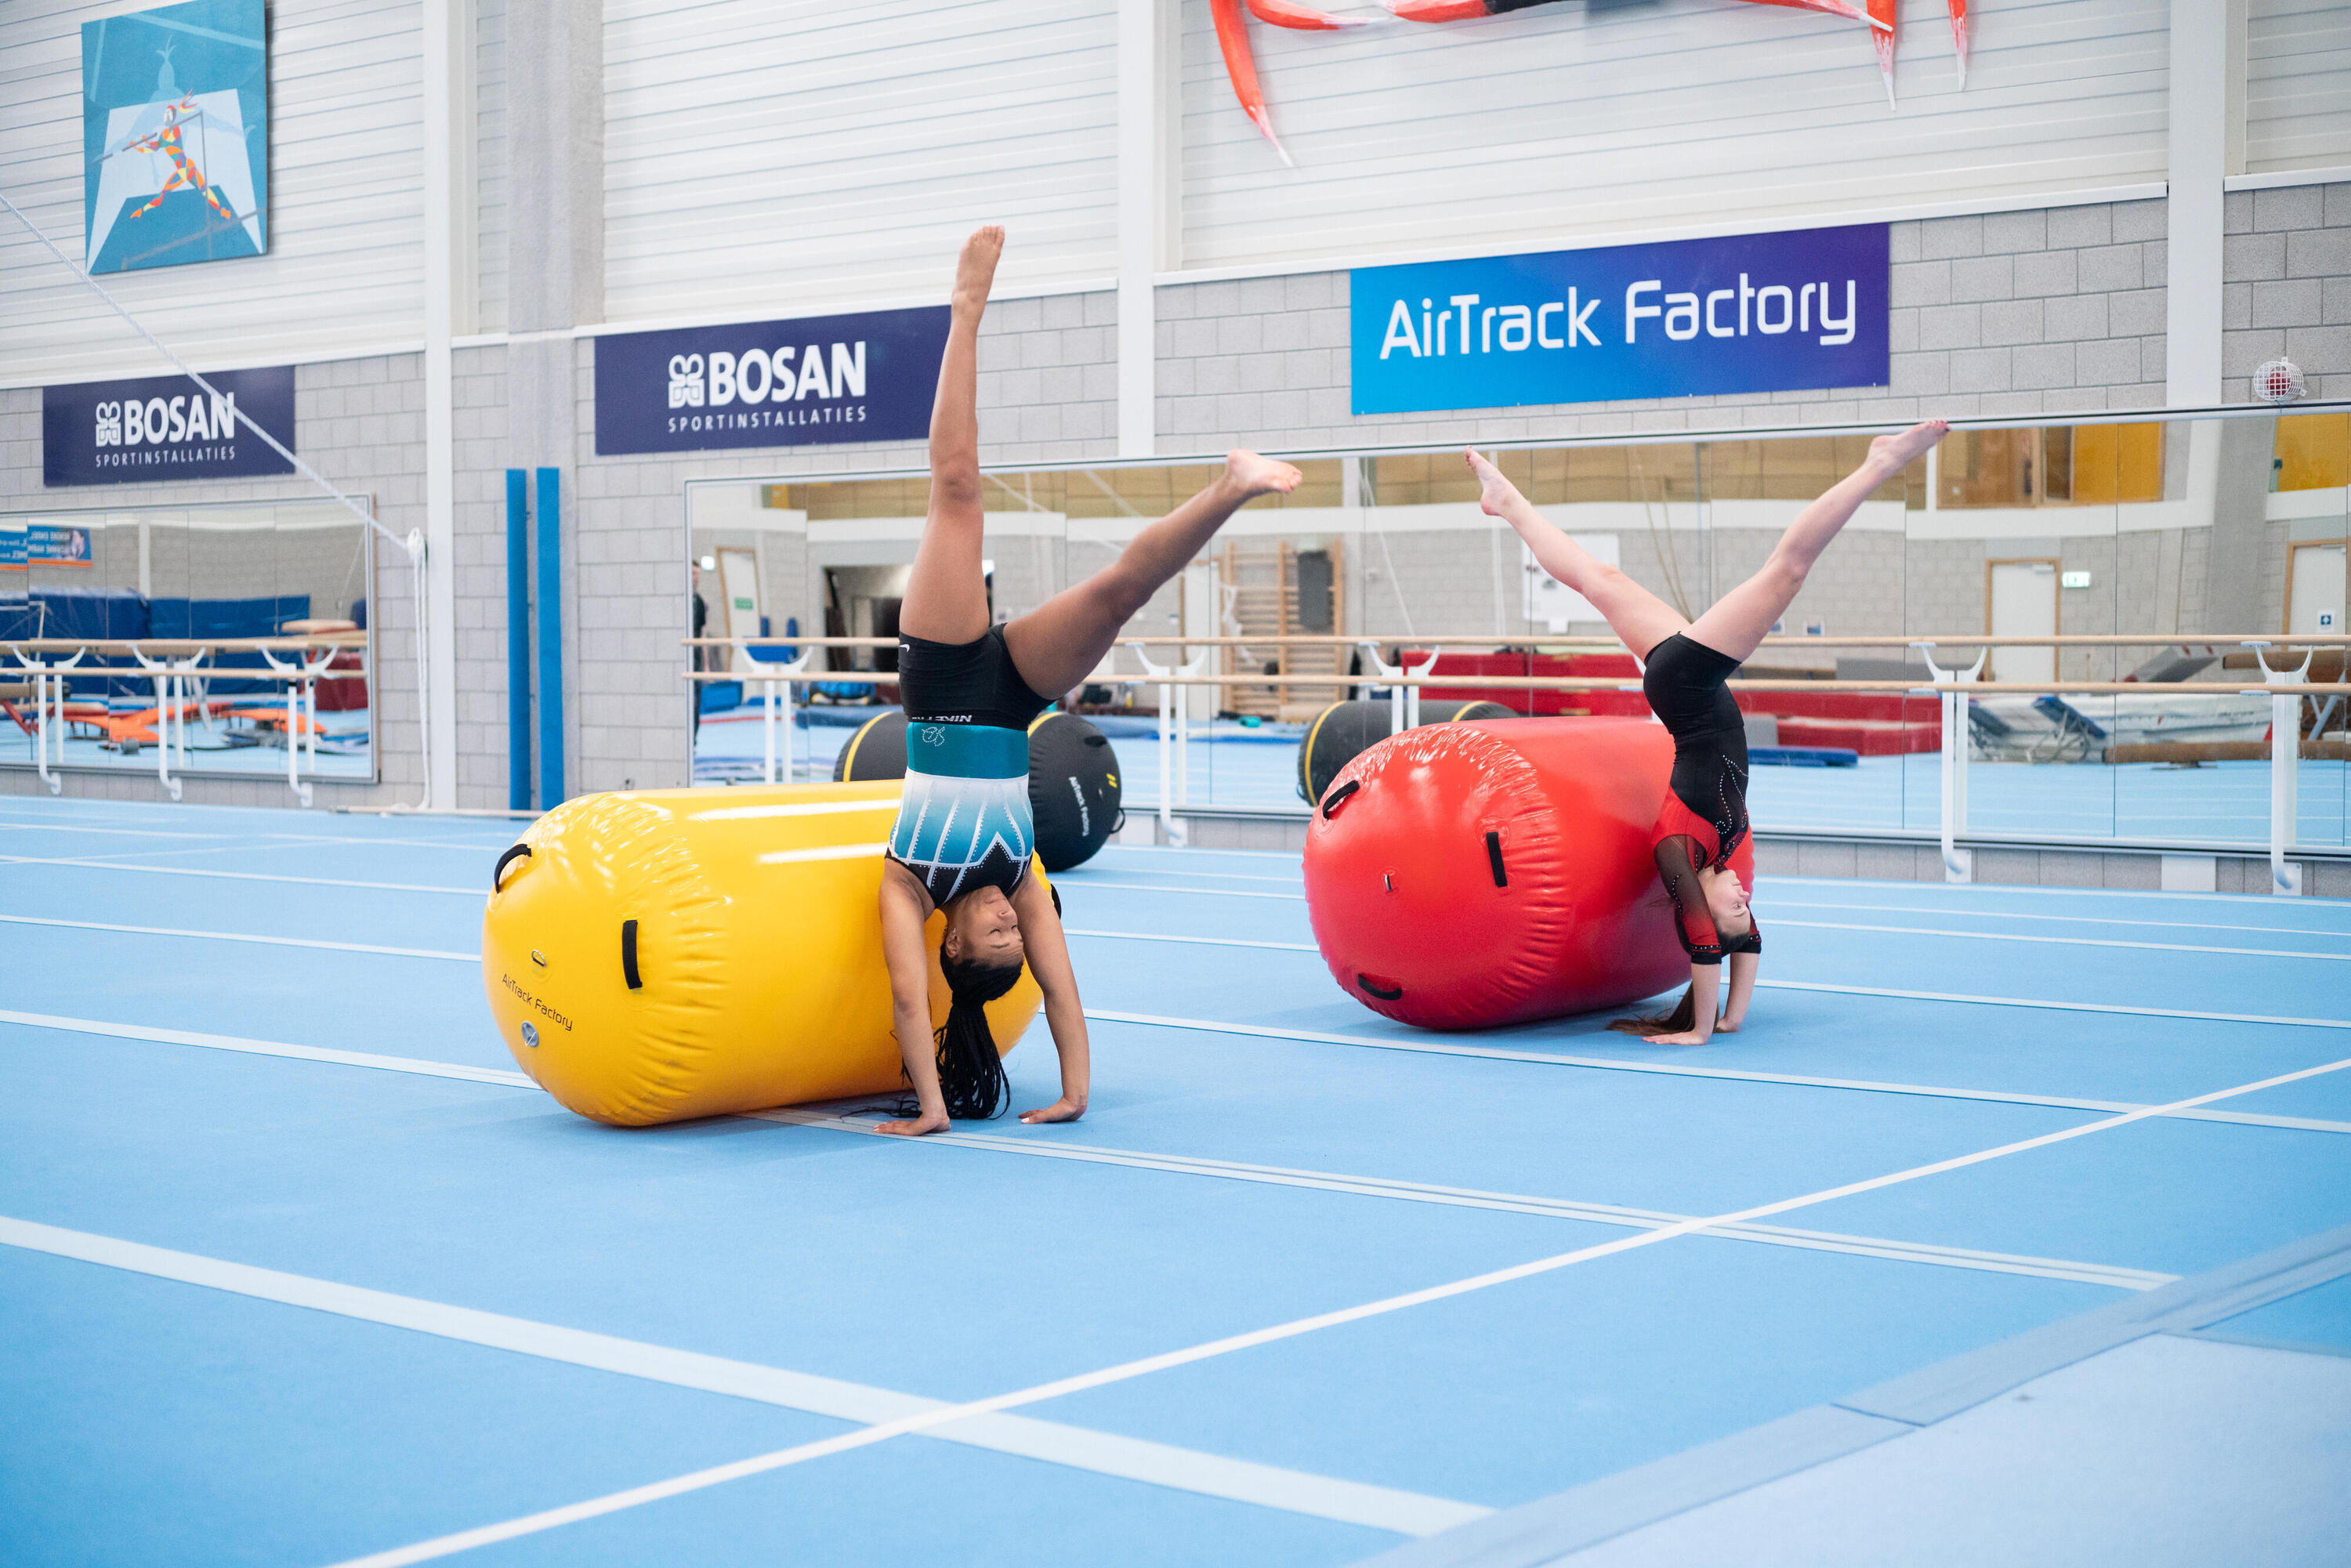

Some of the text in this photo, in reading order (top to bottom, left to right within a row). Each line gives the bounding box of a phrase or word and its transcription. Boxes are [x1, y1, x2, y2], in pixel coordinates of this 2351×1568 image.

[1378, 272, 1857, 360] AirTrack Factory
[708, 340, 867, 406] BOSAN
[124, 392, 235, 445] BOSAN
[667, 404, 867, 434] SPORTINSTALLATIES
[95, 444, 236, 468] SPORTINSTALLATIES
[502, 973, 573, 1032] AirTrack Factory
